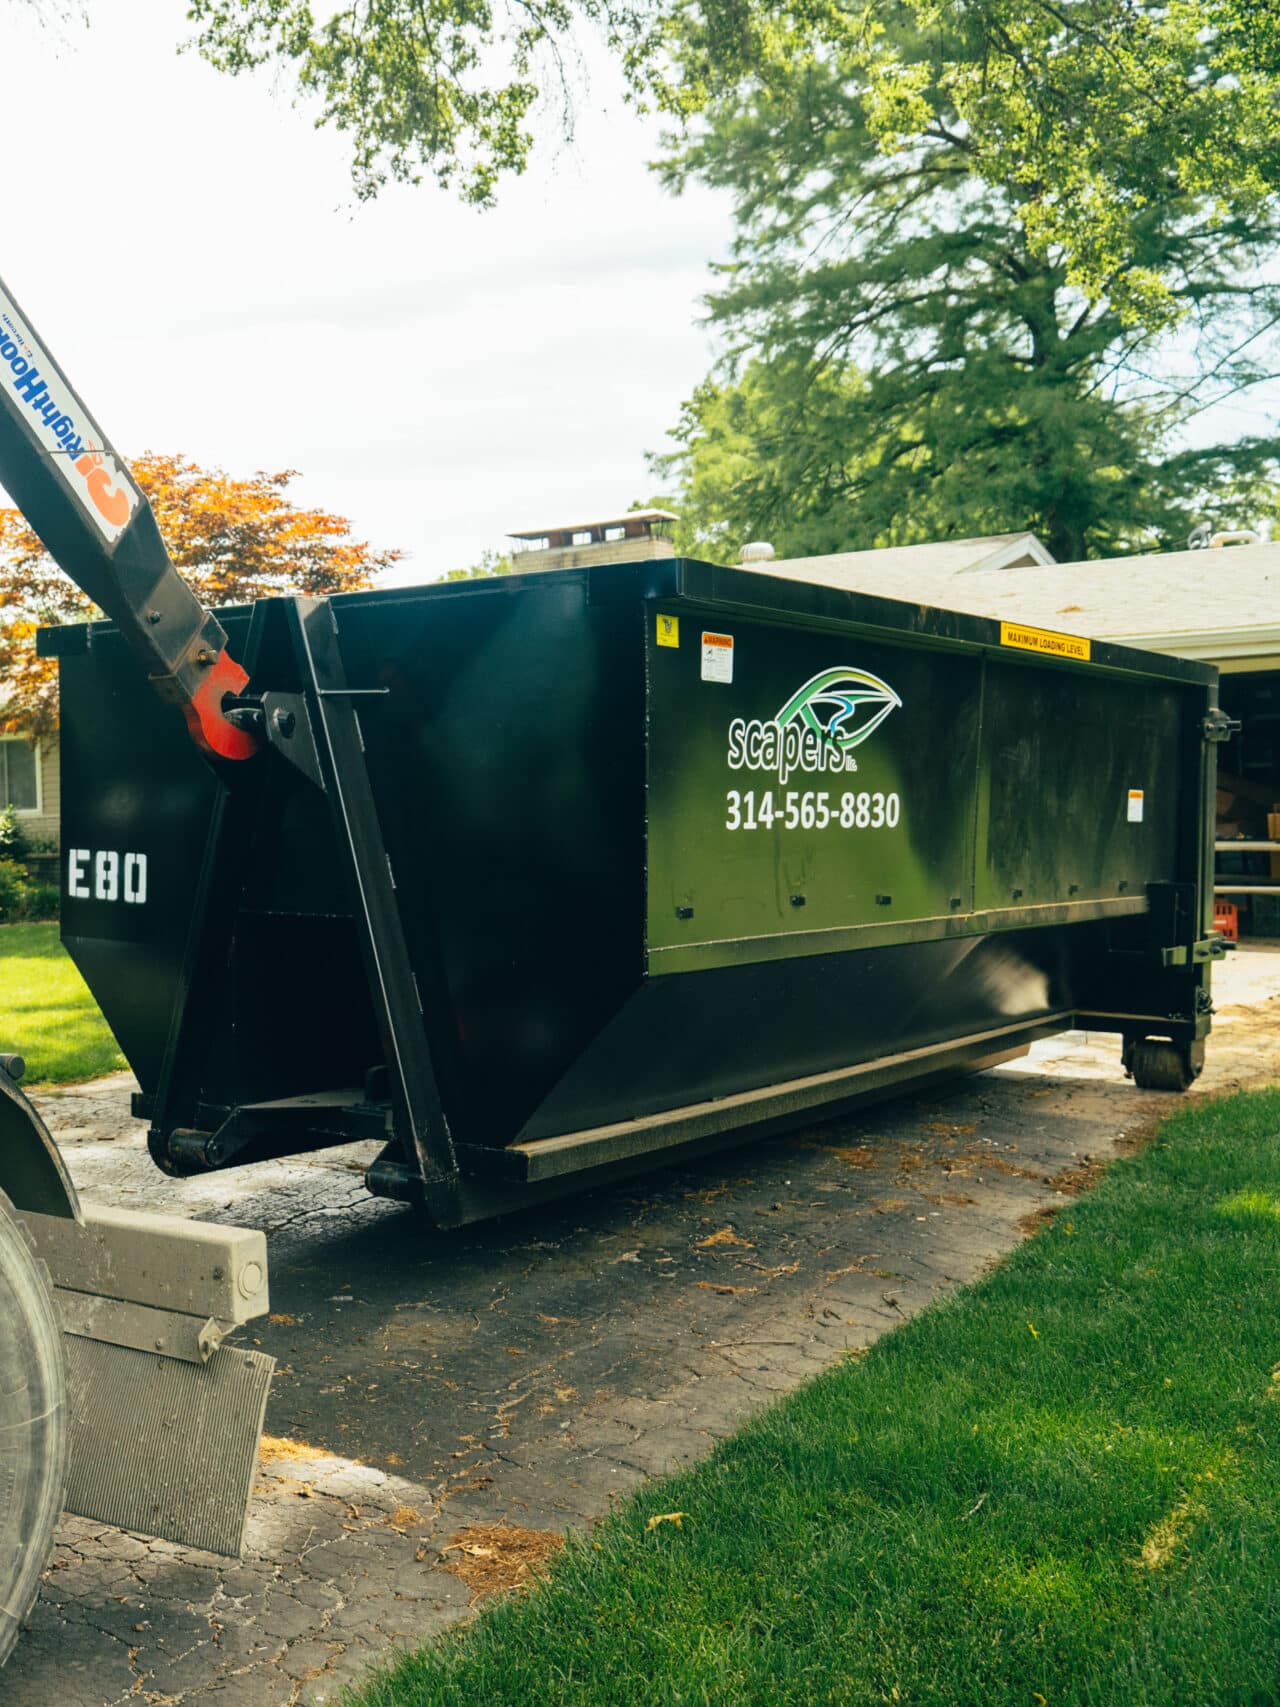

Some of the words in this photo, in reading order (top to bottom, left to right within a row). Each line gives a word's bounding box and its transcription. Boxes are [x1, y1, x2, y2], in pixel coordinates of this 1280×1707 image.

[1007, 631, 1038, 646] MAXIMUM
[1039, 638, 1066, 652] LOADING
[1066, 643, 1084, 657] LEVEL
[727, 717, 846, 785] scapers
[725, 790, 900, 831] 314-565-8830
[68, 848, 147, 904] E80
